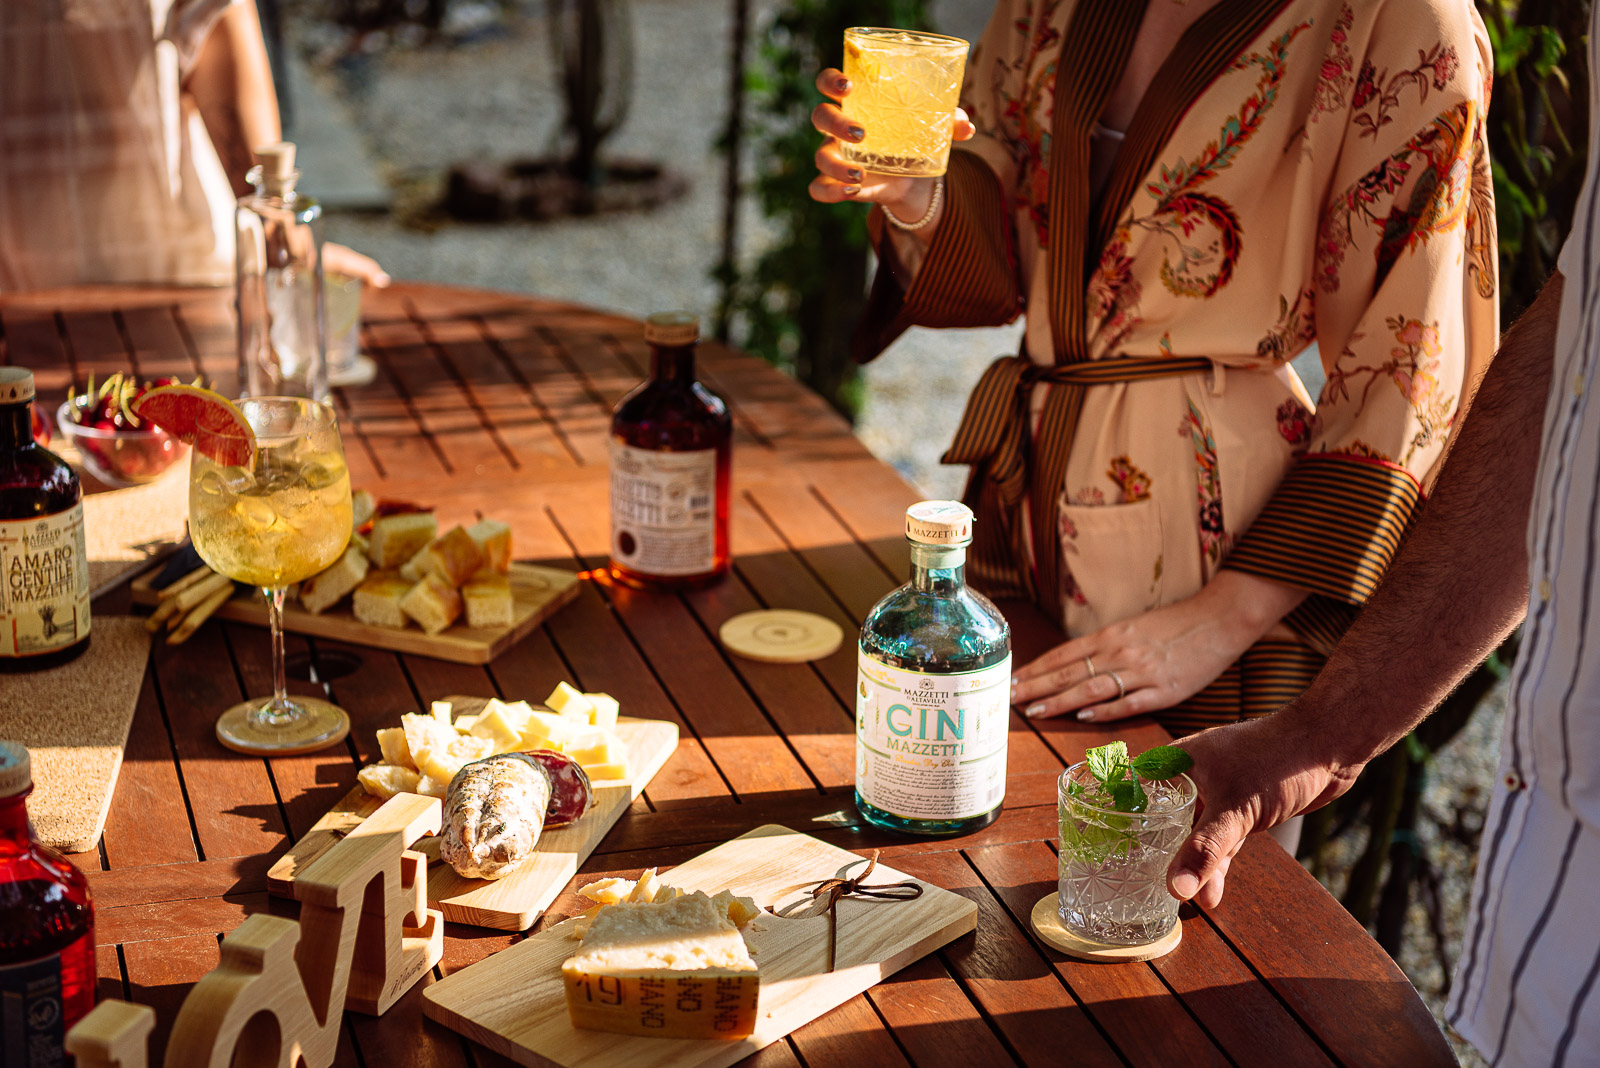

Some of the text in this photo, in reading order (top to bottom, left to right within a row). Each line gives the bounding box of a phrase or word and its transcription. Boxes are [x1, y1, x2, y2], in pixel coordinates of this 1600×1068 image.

[913, 527, 958, 539] MAZZETTI
[11, 544, 73, 571] AMARO
[9, 559, 73, 590] GENTILE
[904, 688, 949, 699] MAZZETTI
[970, 680, 981, 689] 70
[886, 703, 968, 742] GIN
[886, 736, 965, 757] MAZZETTI
[576, 973, 623, 1006] 19
